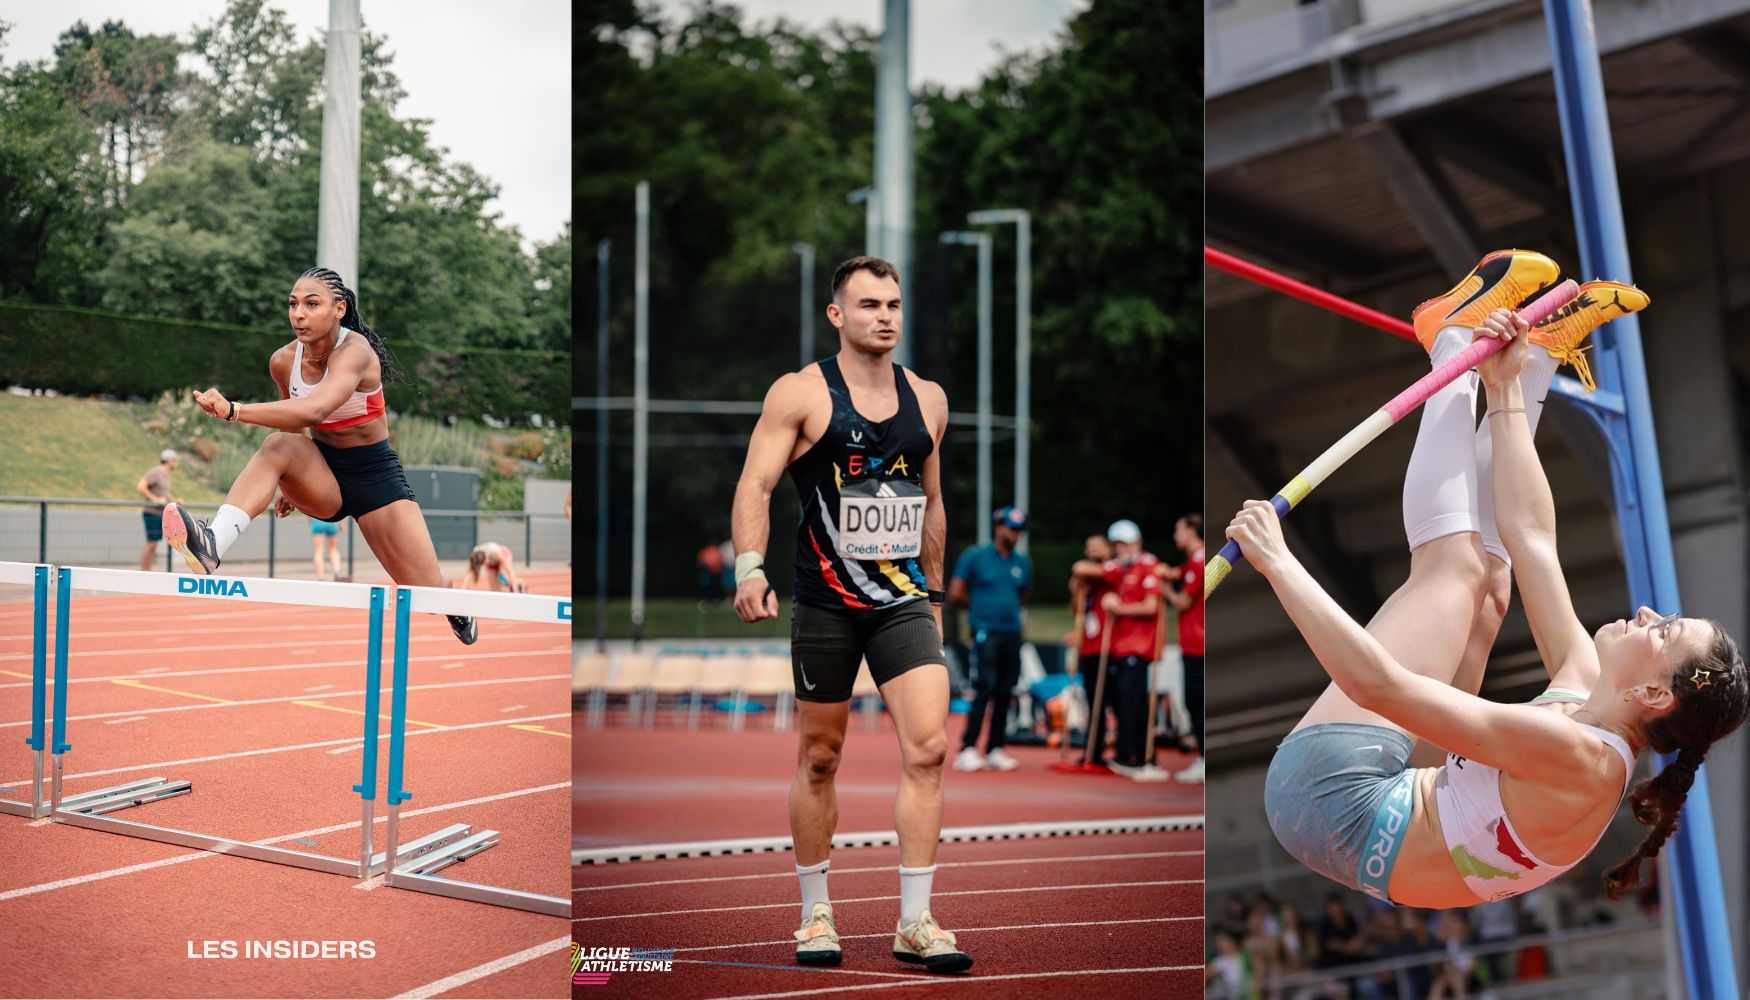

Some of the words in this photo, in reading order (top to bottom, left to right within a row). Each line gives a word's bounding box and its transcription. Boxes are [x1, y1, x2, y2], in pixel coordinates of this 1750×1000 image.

[846, 503, 922, 533] DOUAT
[846, 543, 879, 555] Crédit
[891, 542, 918, 554] Mutuel
[178, 576, 249, 598] DIMA
[1365, 805, 1404, 878] PRO
